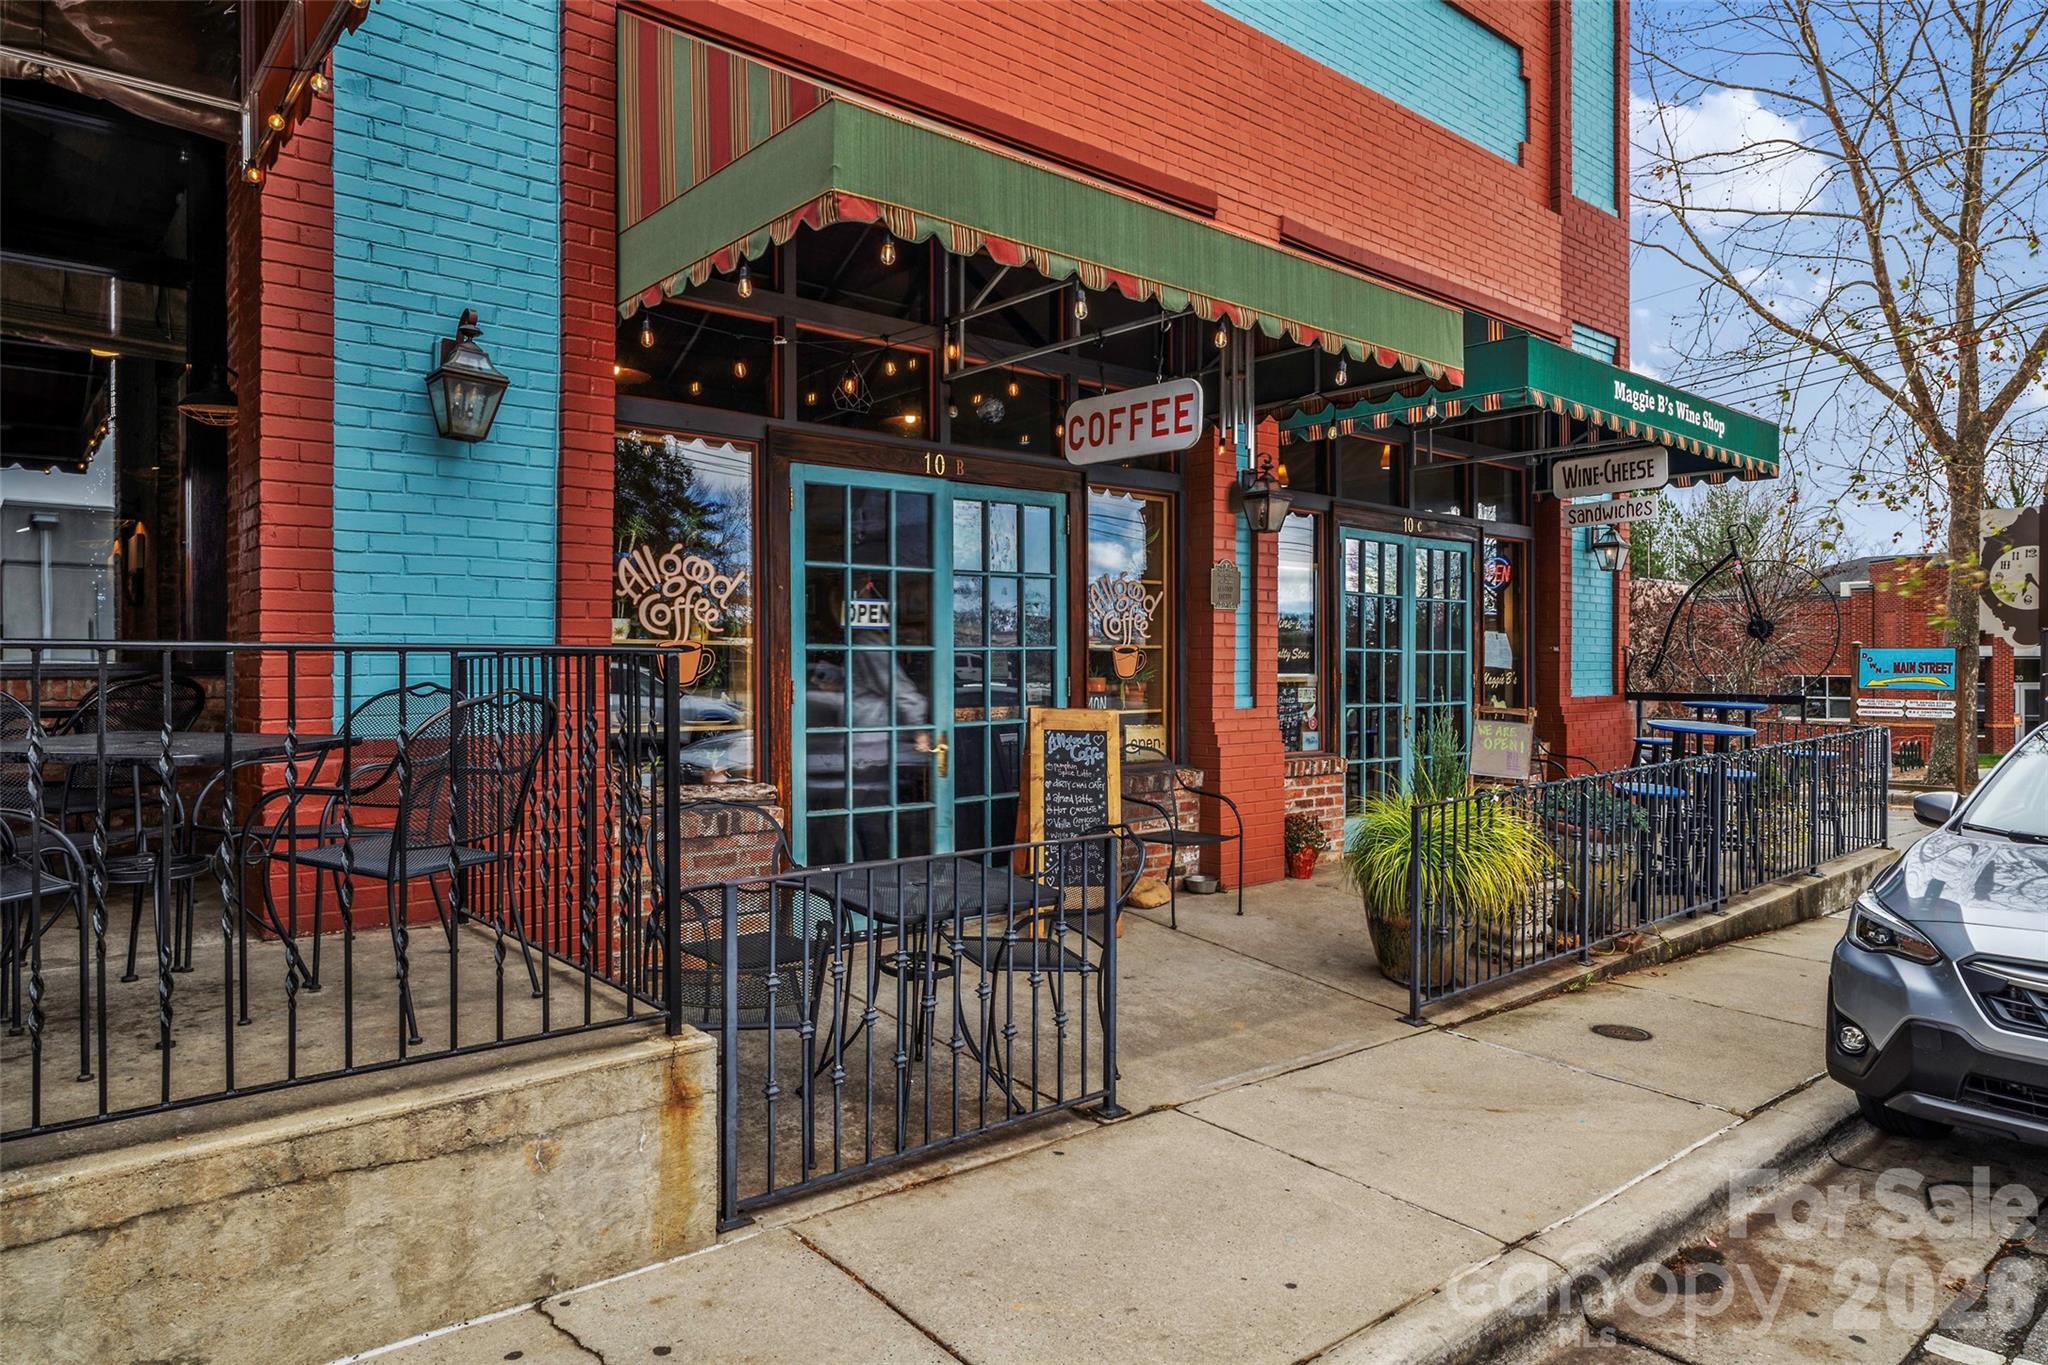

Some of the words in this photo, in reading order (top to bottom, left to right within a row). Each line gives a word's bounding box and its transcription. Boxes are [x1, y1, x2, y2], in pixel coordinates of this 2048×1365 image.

[1069, 393, 1194, 451] COFFEE
[1613, 379, 1655, 413] Maggie
[1657, 394, 1674, 416] B's
[1675, 400, 1701, 427] Wine
[1702, 410, 1726, 438] Shop
[924, 452, 945, 476] 10
[956, 459, 964, 476] B
[1403, 516, 1414, 533] 10
[615, 543, 746, 609] Allgood
[1089, 571, 1164, 622] Allgood
[638, 585, 725, 642] Coffee
[1102, 604, 1152, 646] Coffee
[1861, 652, 1882, 673] DOWN
[1893, 662, 1916, 673] MAIN
[1918, 662, 1953, 674] STREET
[1477, 724, 1493, 736] WE
[1495, 726, 1517, 738] ARE
[1069, 744, 1105, 766] Coffee
